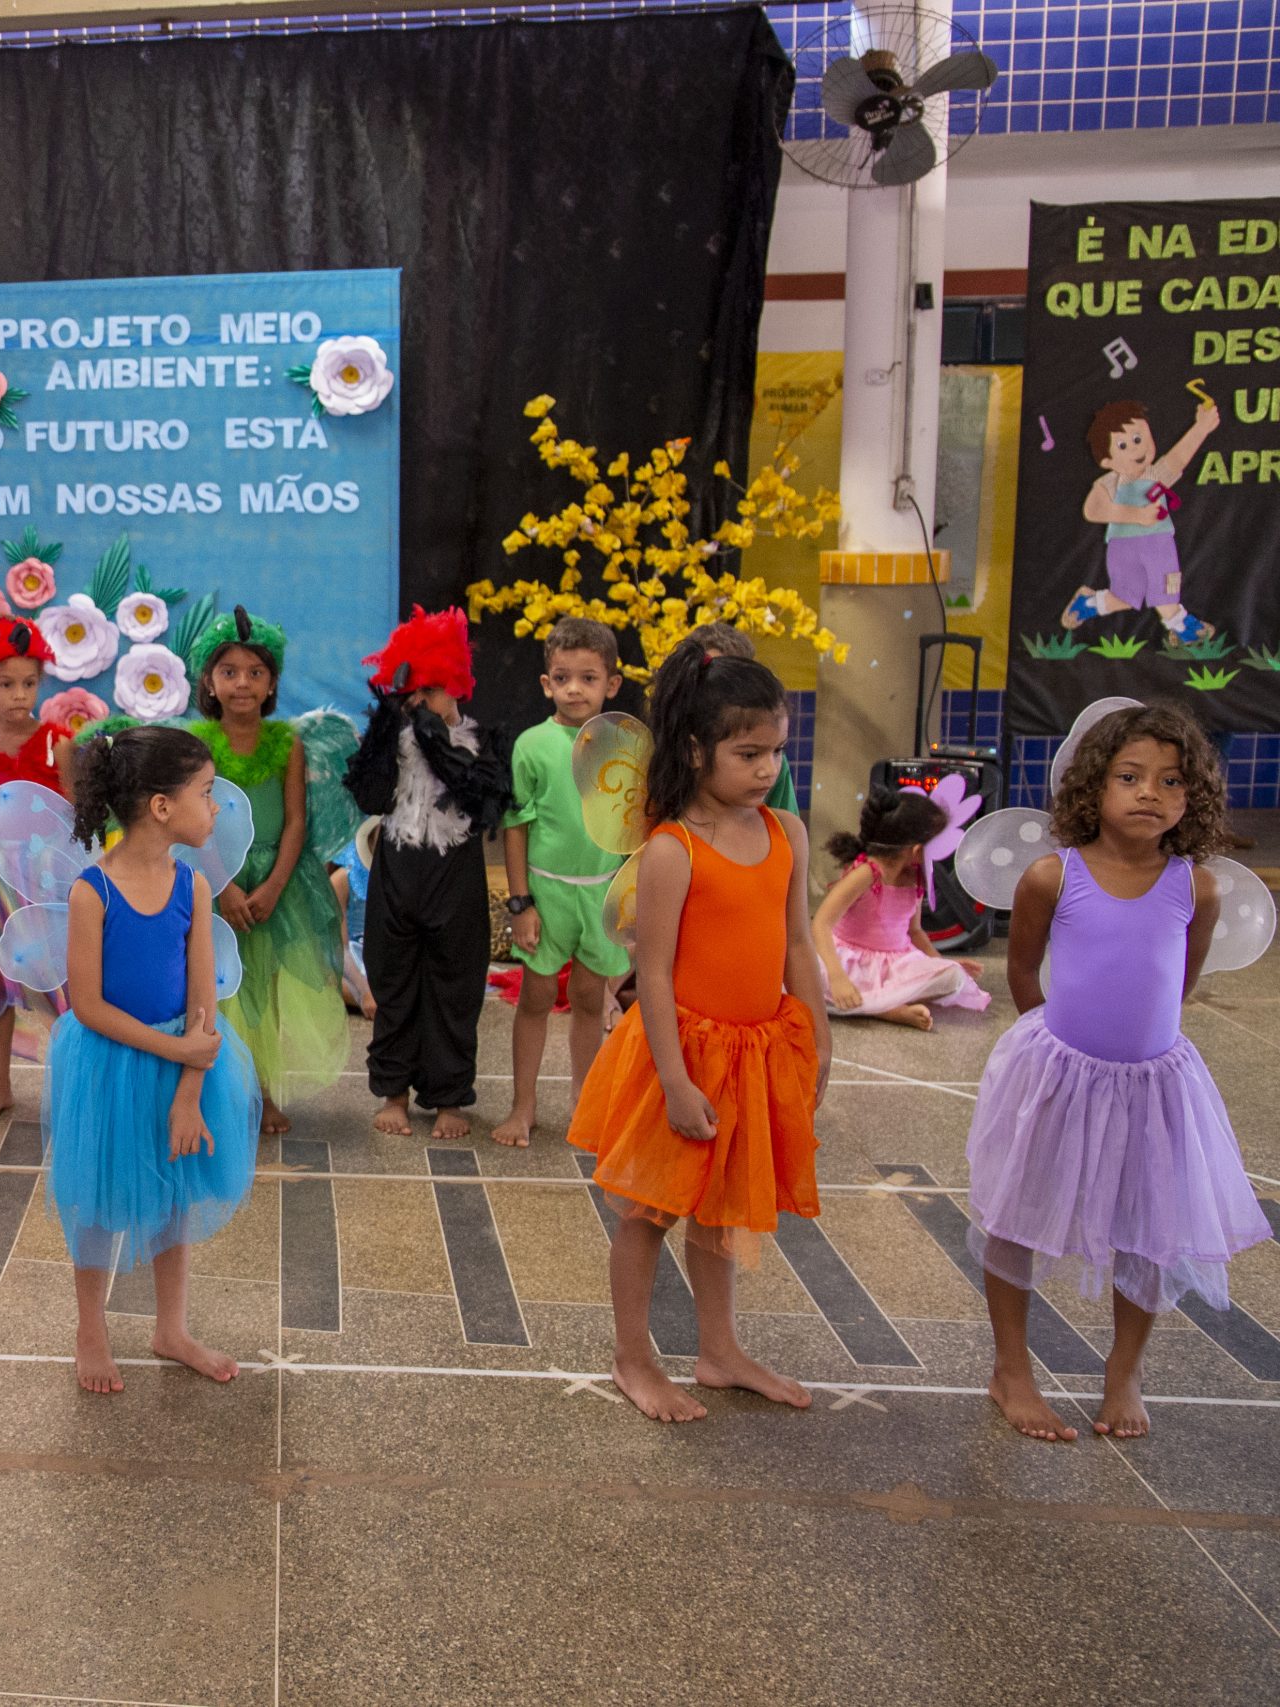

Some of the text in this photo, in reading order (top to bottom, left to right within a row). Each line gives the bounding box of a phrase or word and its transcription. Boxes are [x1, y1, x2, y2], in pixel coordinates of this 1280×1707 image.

[1077, 215, 1280, 263] É NA ED
[1046, 275, 1280, 319] QUE CADA
[220, 311, 322, 344] MEIO
[1193, 327, 1280, 365] DES
[45, 356, 272, 391] AMBIENTE:
[1234, 388, 1280, 423] U
[26, 419, 189, 452] FUTURO
[1197, 450, 1280, 485] APR
[57, 482, 222, 515] NOSSAS
[240, 473, 360, 514] MÃOS
